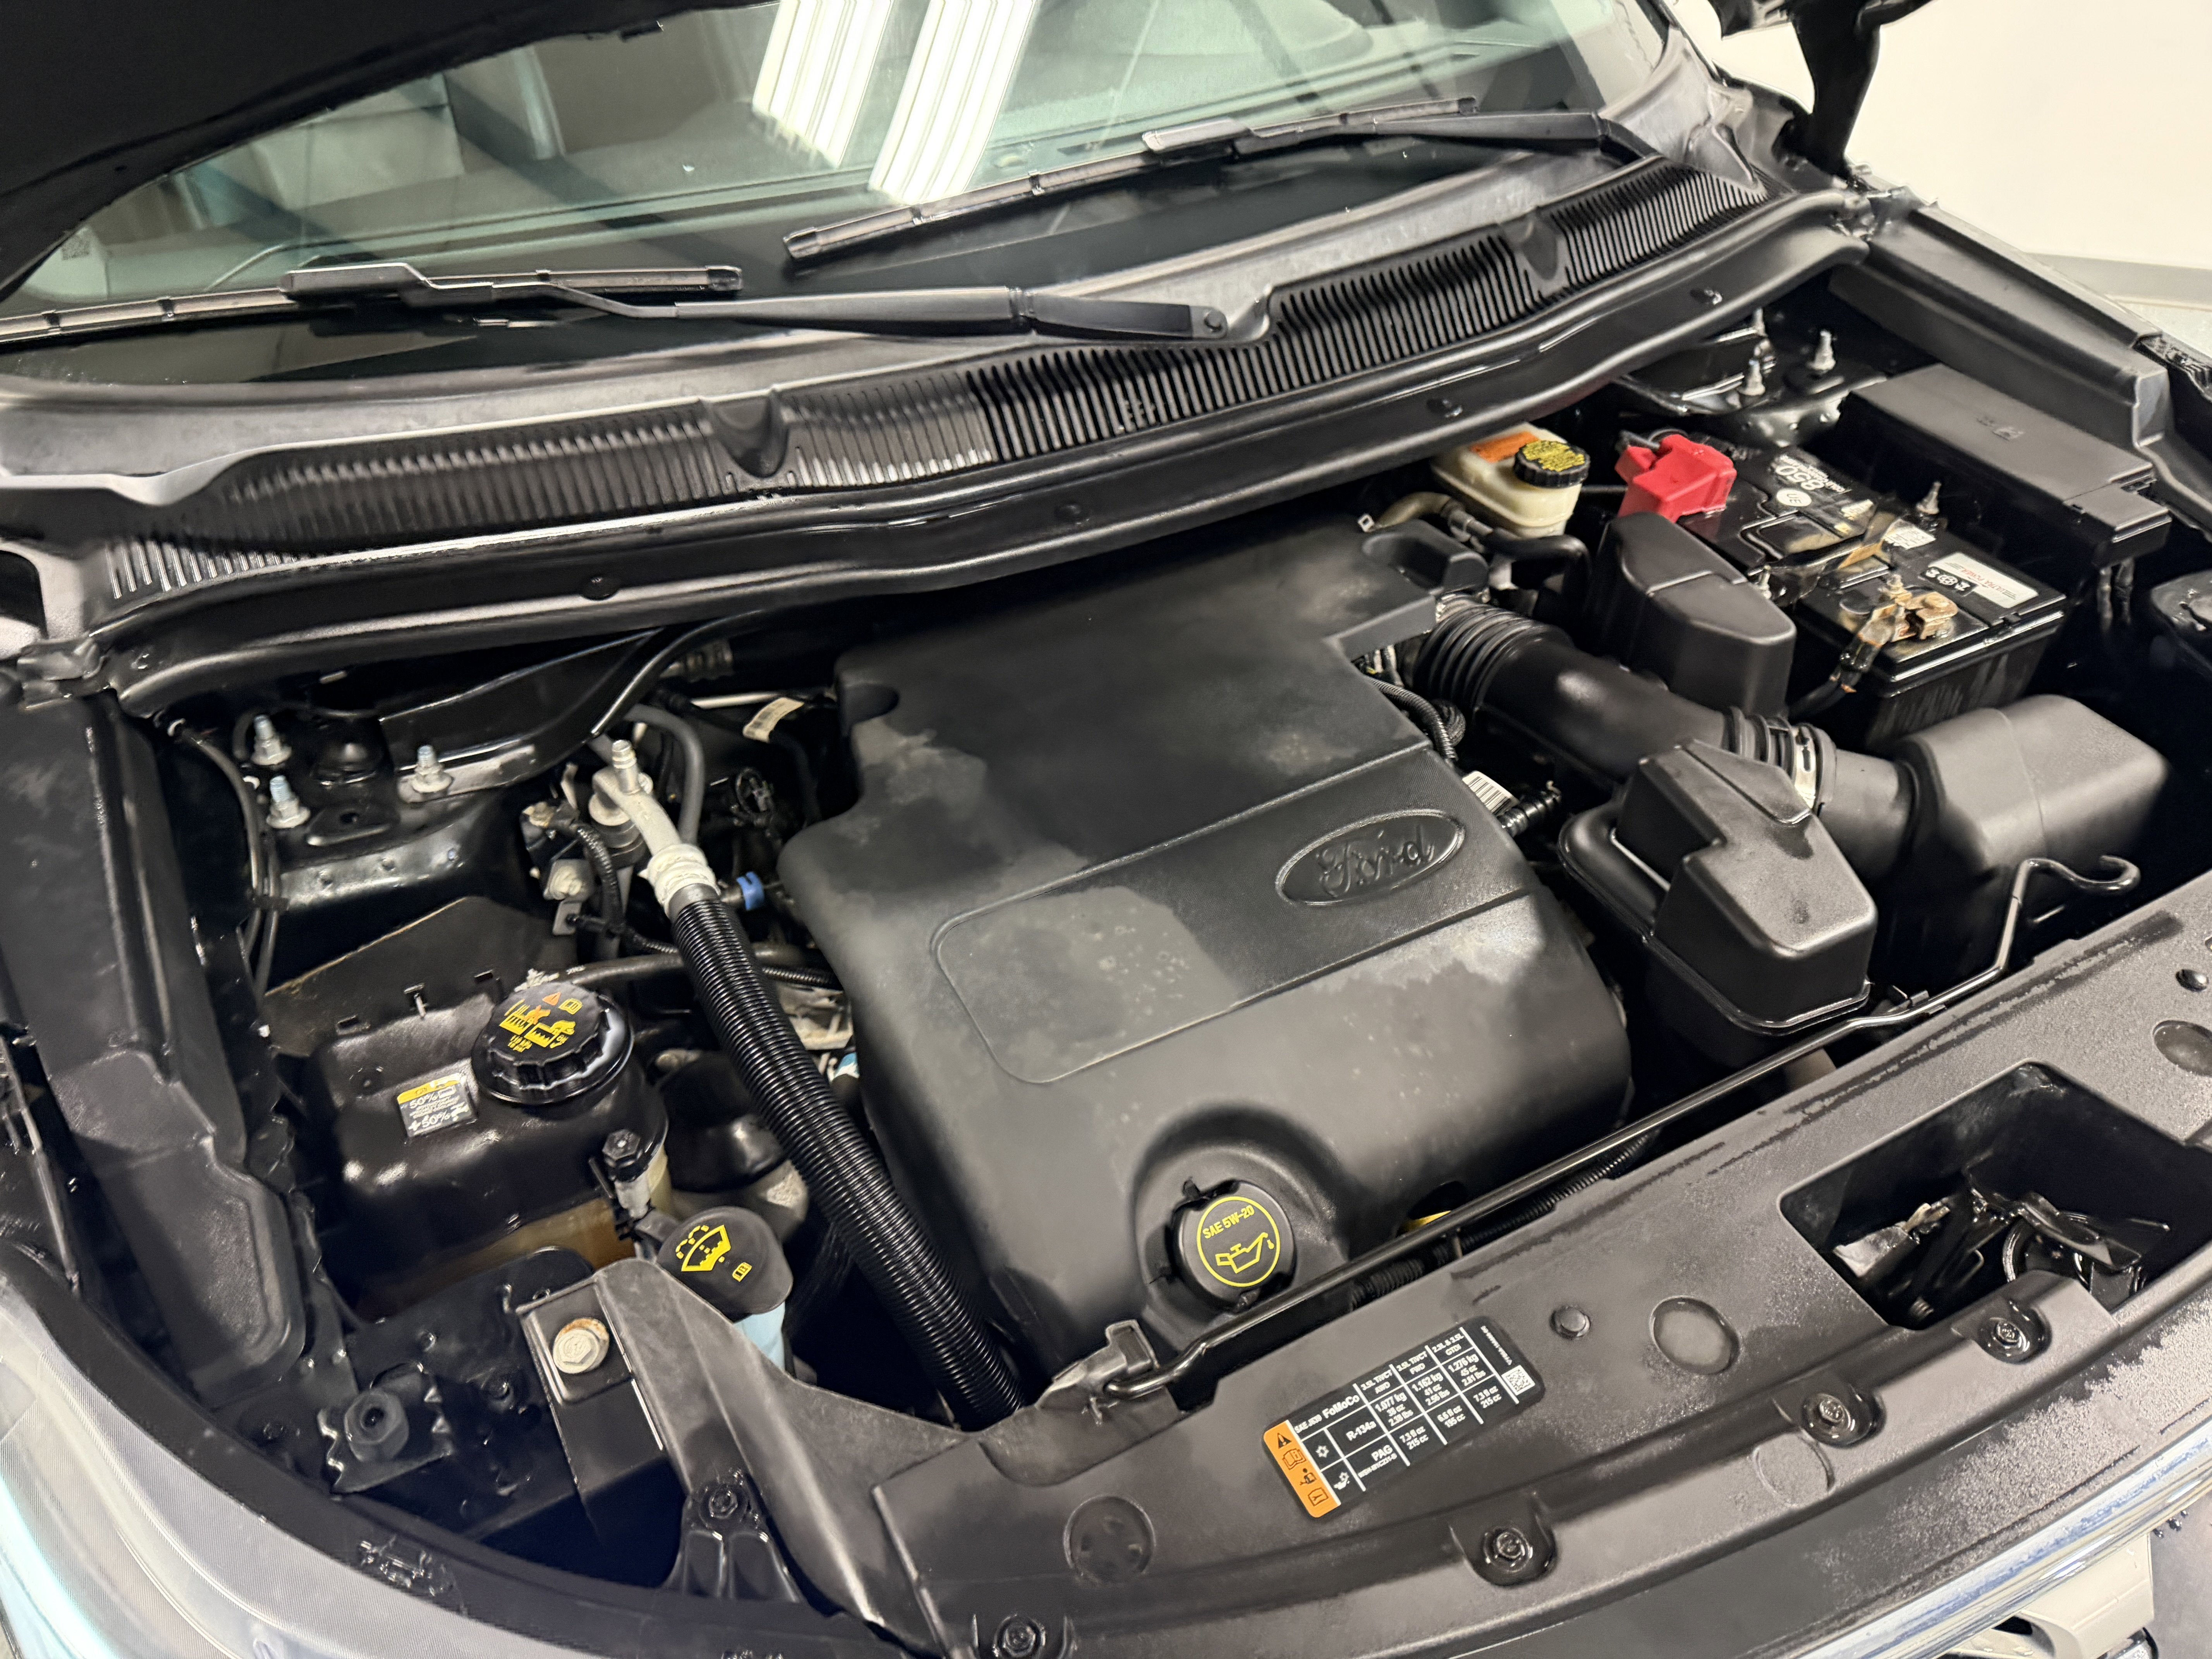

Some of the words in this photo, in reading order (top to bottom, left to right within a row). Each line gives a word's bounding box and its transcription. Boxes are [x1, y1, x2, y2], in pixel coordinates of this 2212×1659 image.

[1775, 465, 1824, 490] 850
[1316, 825, 1435, 898] Ford
[410, 1092, 438, 1108] 50%
[1202, 1221, 1224, 1239] SAE
[1223, 1205, 1254, 1228] 5W-20
[1410, 1363, 1425, 1374] FWD
[1448, 1357, 1468, 1372] 1.276
[1466, 1354, 1479, 1363] kg
[1461, 1368, 1469, 1376] 45
[1474, 1370, 1486, 1379] lbs
[1375, 1382, 1390, 1394] AWD
[1412, 1376, 1433, 1391] 1.162
[1430, 1372, 1443, 1382] kg
[1424, 1387, 1433, 1395] 41
[1432, 1384, 1442, 1392] oz
[1438, 1389, 1450, 1399] lbs
[1473, 1392, 1487, 1402] 7.3
[1322, 1395, 1360, 1419] FoMoCo
[1375, 1396, 1395, 1412] 1.077
[1393, 1392, 1407, 1402] kg
[1396, 1404, 1406, 1412] oz
[1453, 1405, 1462, 1413] oz
[1480, 1397, 1494, 1408] 215
[1401, 1410, 1413, 1419] lbs
[1346, 1421, 1376, 1441] R-134a
[1400, 1432, 1412, 1443] 7.3
[1416, 1426, 1425, 1434] oz
[1407, 1437, 1420, 1449] 215
[1419, 1434, 1429, 1443] cc
[1371, 1445, 1393, 1461] PAG
